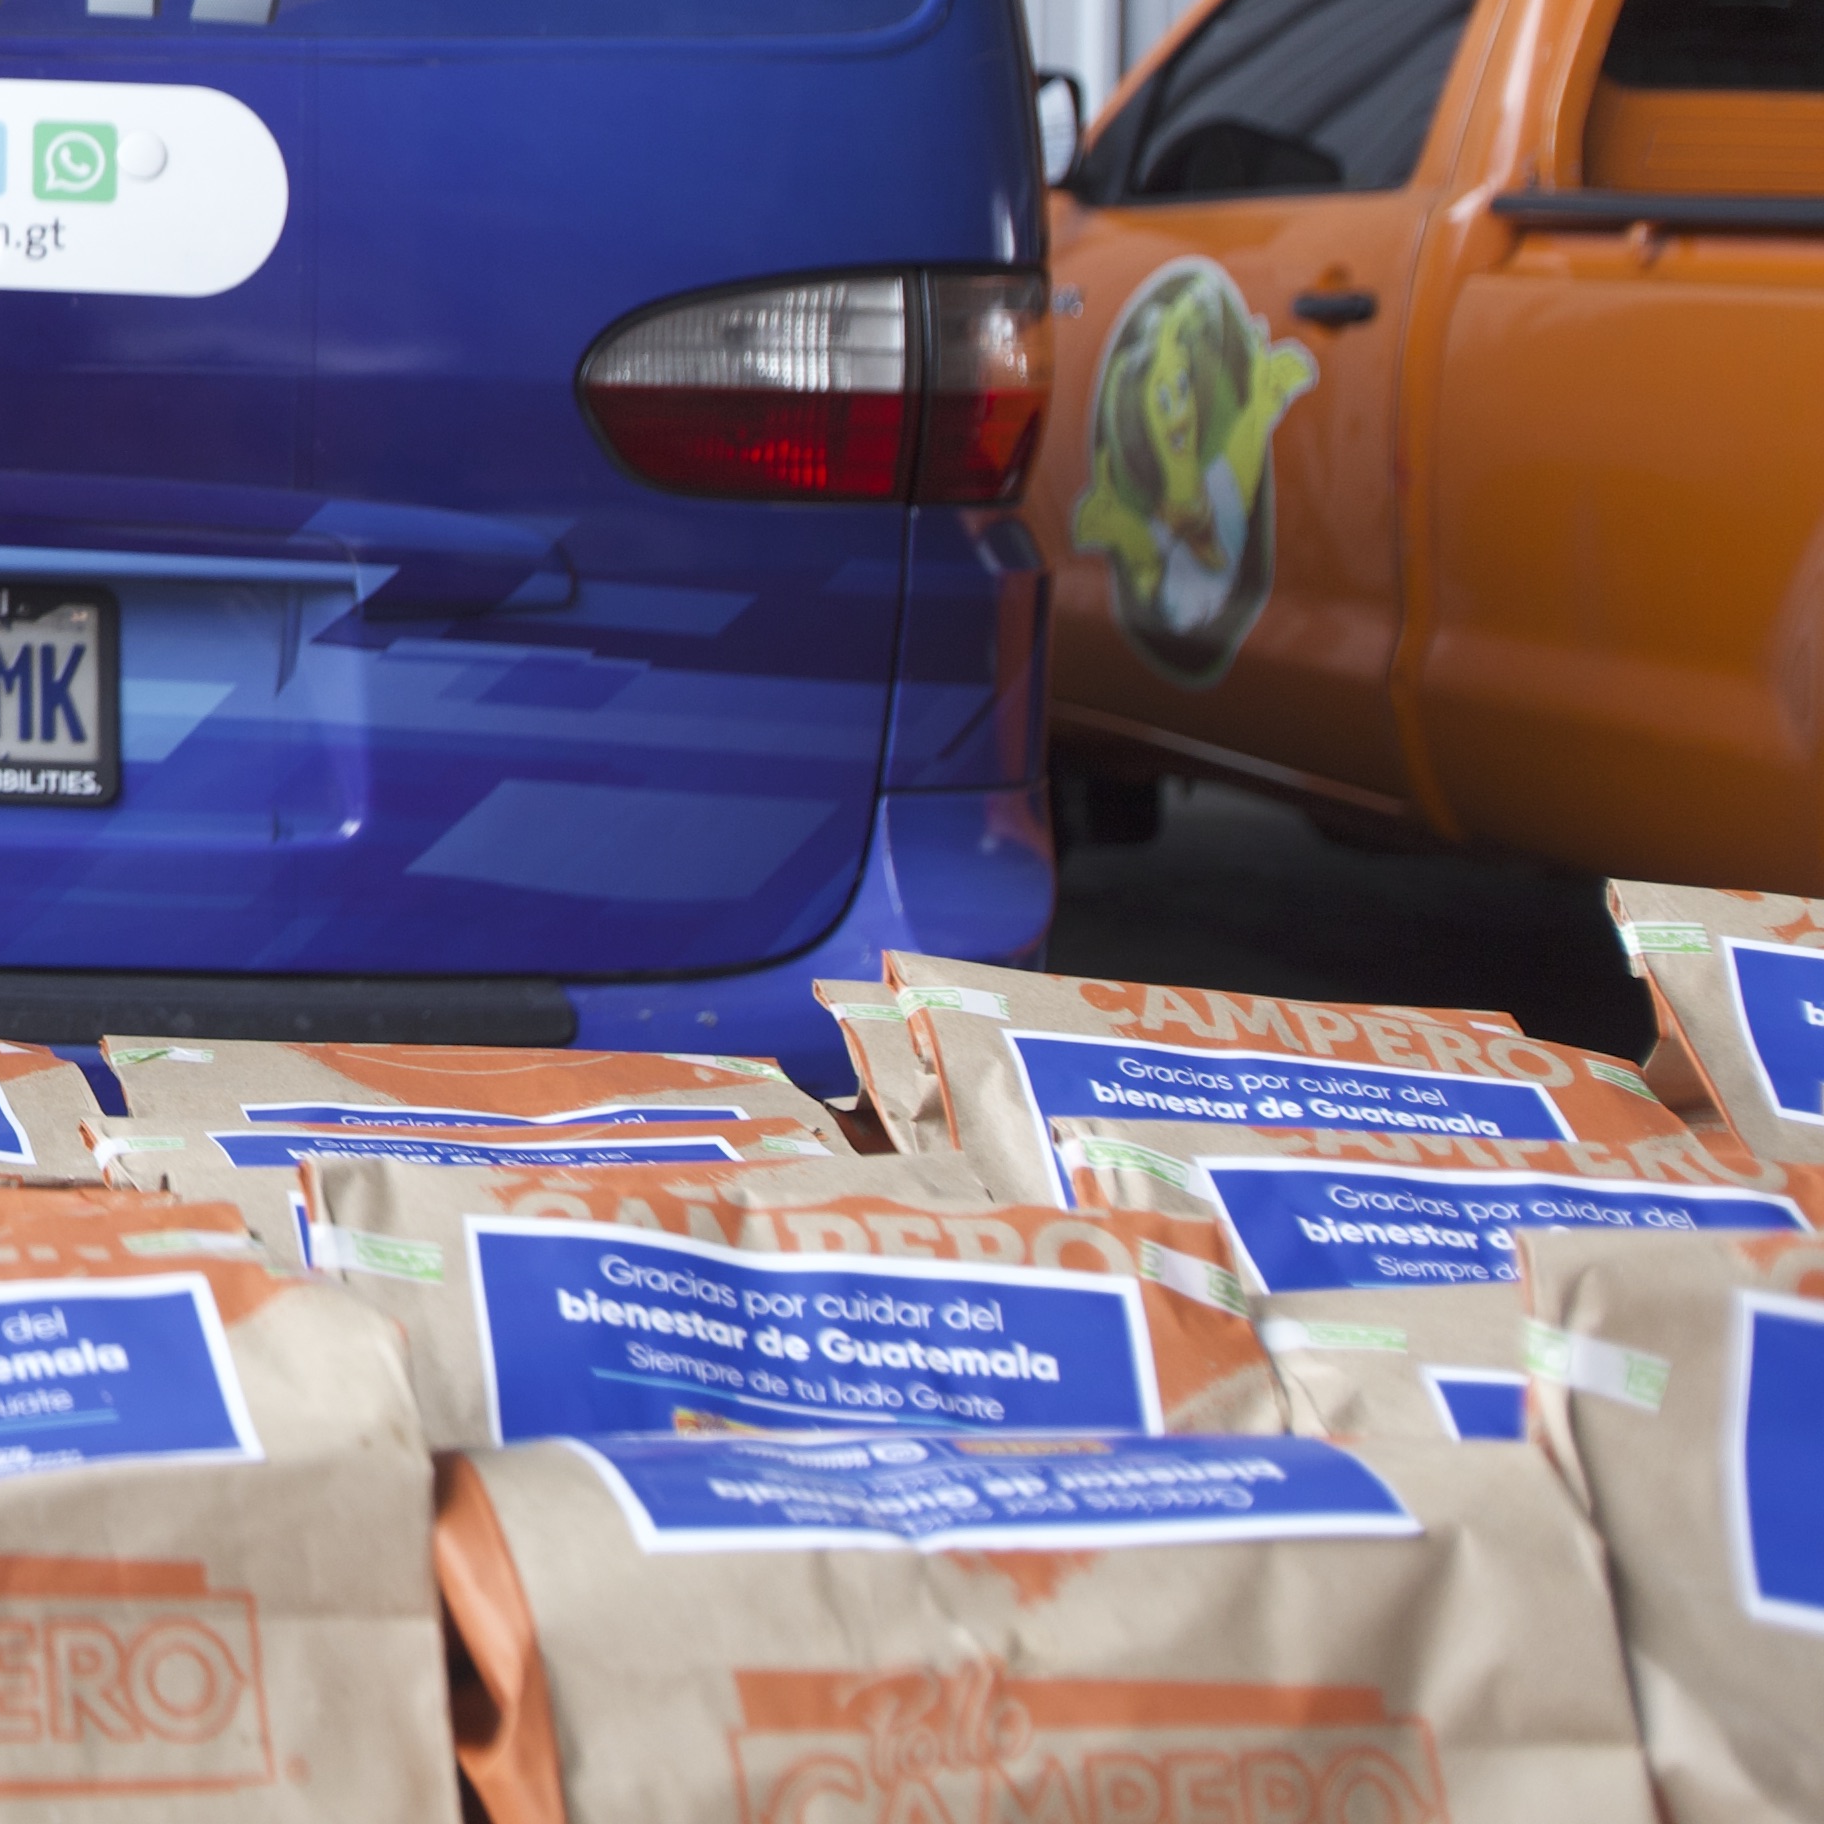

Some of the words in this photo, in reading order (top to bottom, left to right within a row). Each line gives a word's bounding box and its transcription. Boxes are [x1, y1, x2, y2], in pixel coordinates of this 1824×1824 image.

[1080, 977, 1574, 1087] CAMPERO
[1090, 1079, 1249, 1121] bienestar
[1257, 1093, 1305, 1119] de
[1310, 1097, 1504, 1138] Guatemala
[1119, 1056, 1234, 1091] Gracias
[1239, 1075, 1291, 1099] por
[1296, 1074, 1392, 1103] cuidar
[1400, 1081, 1448, 1107] del
[1299, 1216, 1468, 1253] bienestar
[1476, 1225, 1514, 1252] d
[1329, 1184, 1459, 1220] Gracias
[1464, 1197, 1521, 1226] por
[1530, 1196, 1634, 1229] cuidar
[1643, 1202, 1698, 1230] del
[598, 1252, 738, 1308] Gracias
[743, 1288, 806, 1322] por
[814, 1290, 933, 1331] cuidar
[941, 1297, 1004, 1335] del
[1375, 1253, 1491, 1284] Siempre
[2, 1305, 69, 1342] del
[557, 1286, 747, 1351] bienestar
[755, 1324, 811, 1363] de
[816, 1326, 1061, 1383] Guatemala
[626, 1340, 745, 1389] Siempre
[750, 1368, 790, 1399] de
[796, 1375, 827, 1404] tu
[832, 1375, 905, 1411] lado
[910, 1380, 1005, 1423] Guate
